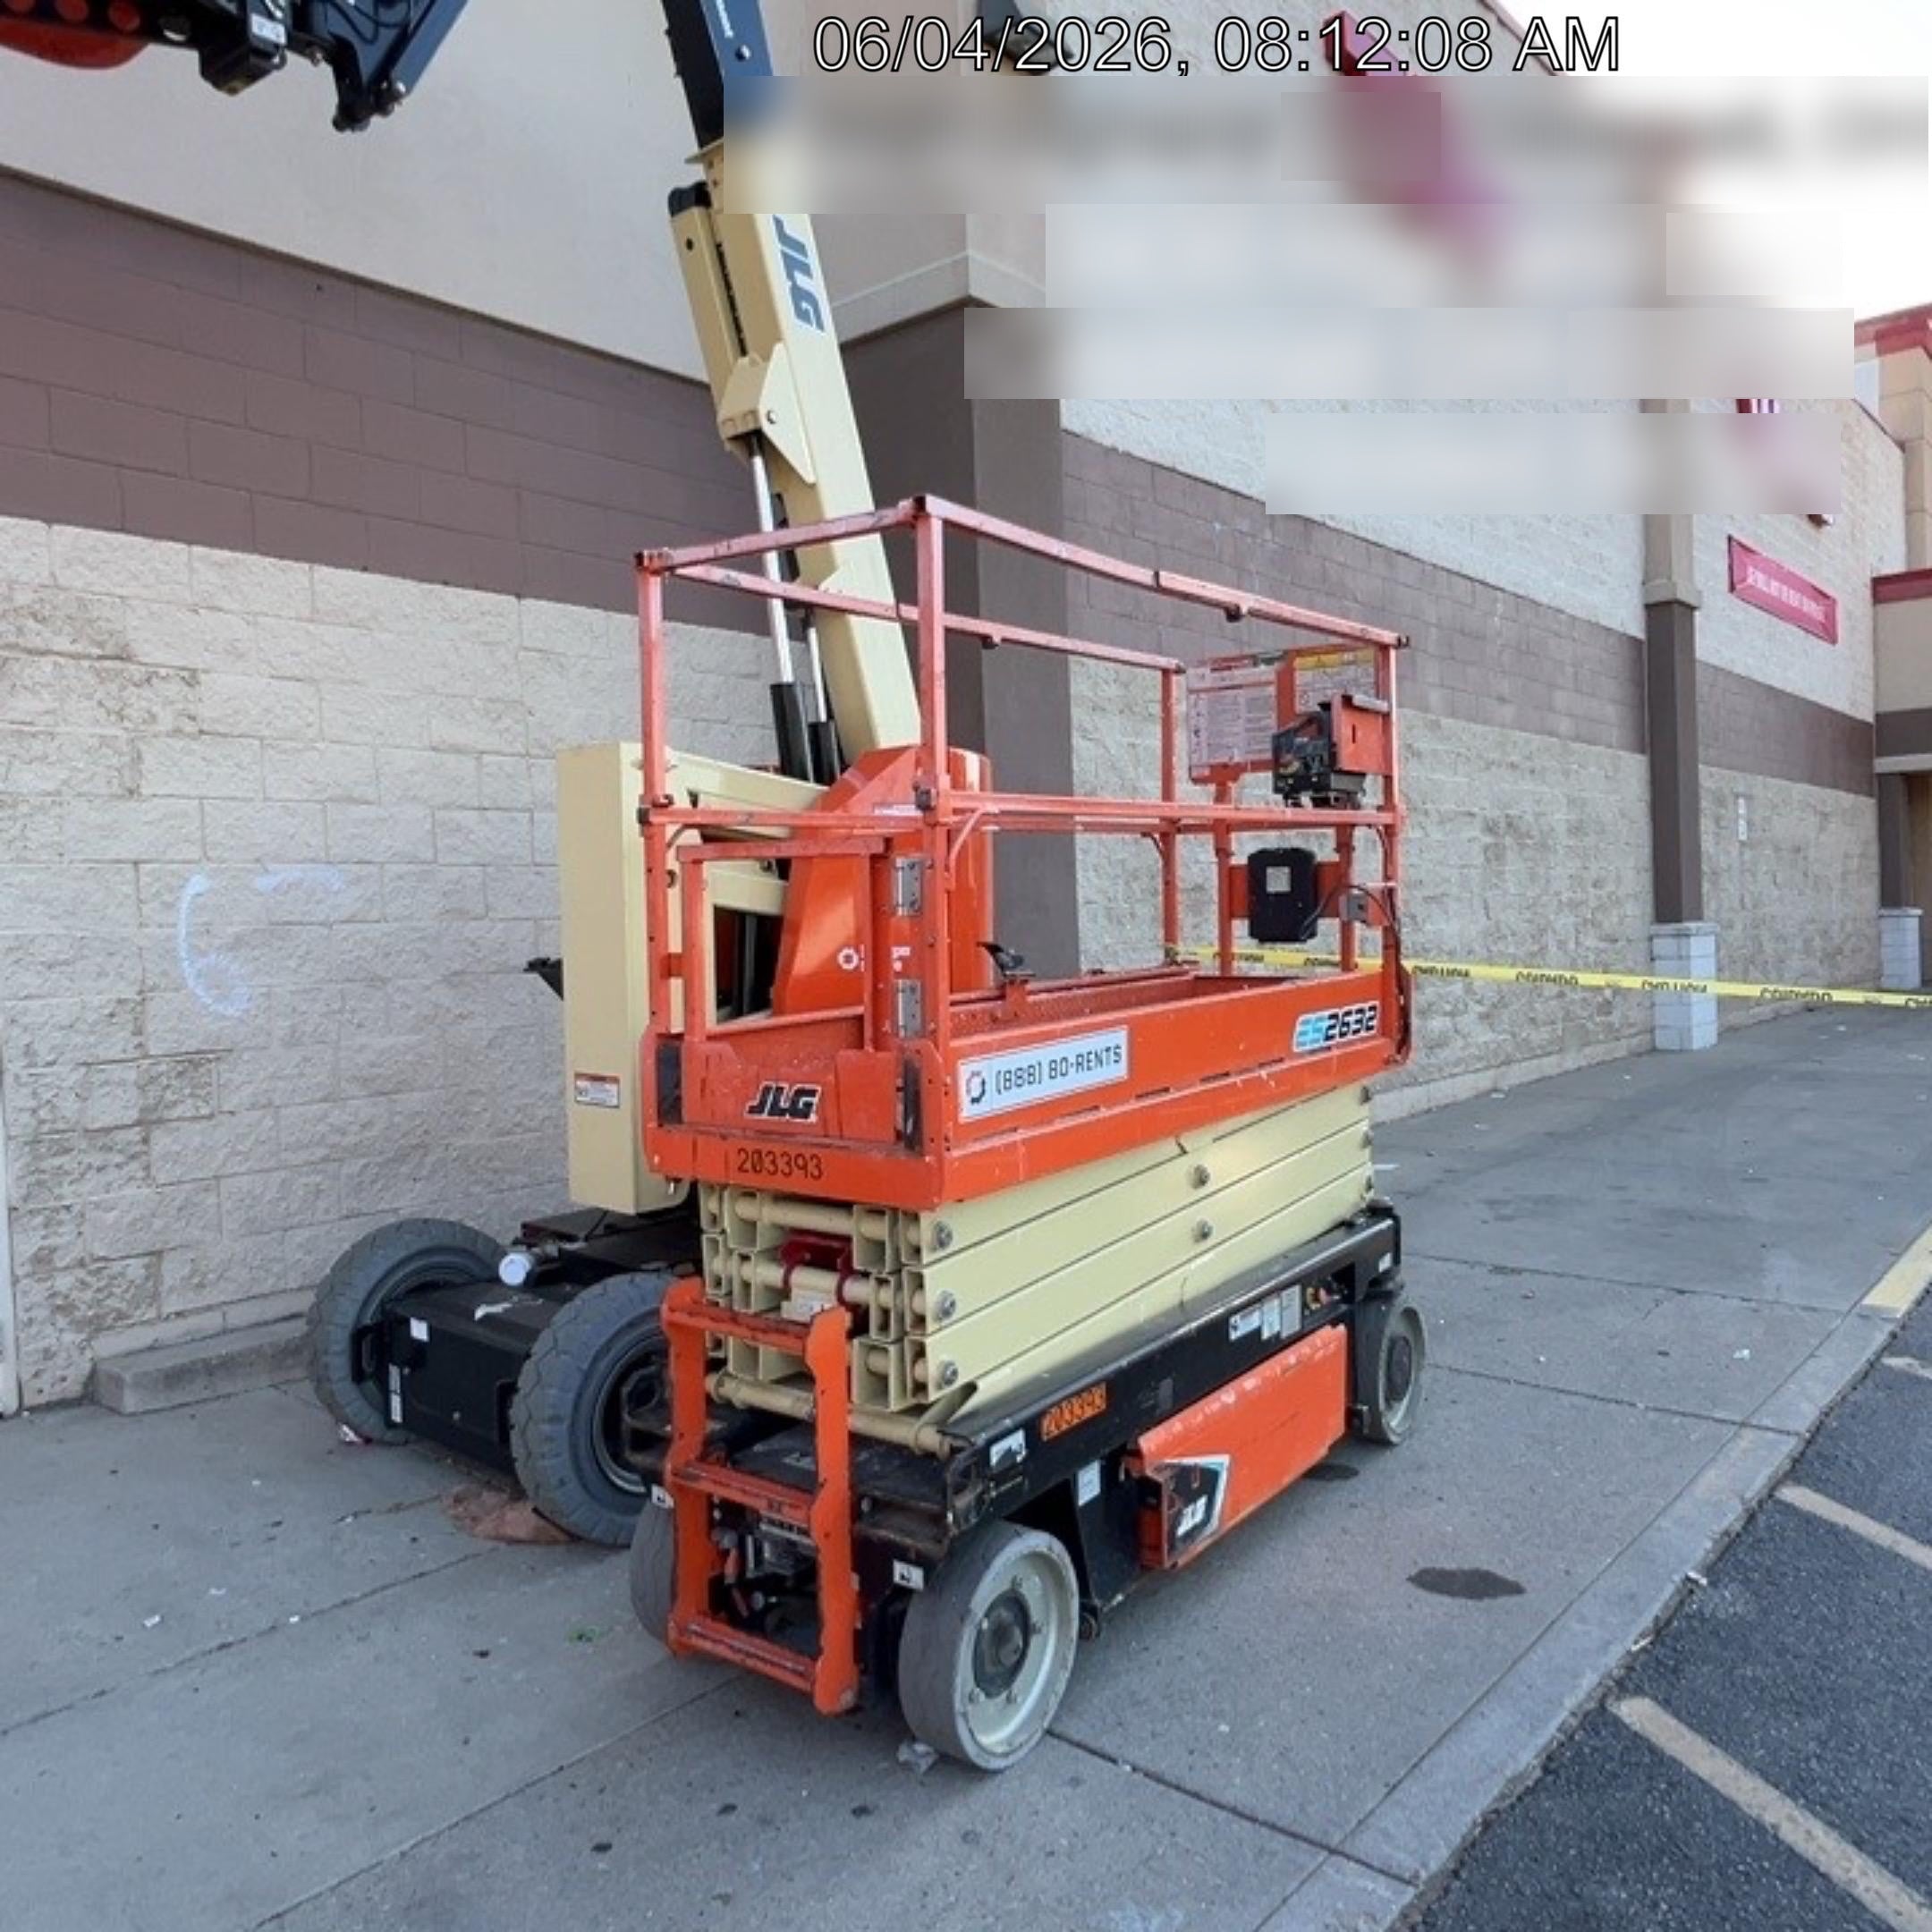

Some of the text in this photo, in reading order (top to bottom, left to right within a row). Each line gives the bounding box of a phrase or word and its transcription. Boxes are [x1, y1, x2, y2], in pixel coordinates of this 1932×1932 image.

[772, 214, 825, 334] JLG
[1296, 1004, 1377, 1047] ES2632
[1048, 1044, 1122, 1080] 80-RENTS
[746, 1083, 820, 1120] JLG
[737, 1148, 824, 1181] 203393
